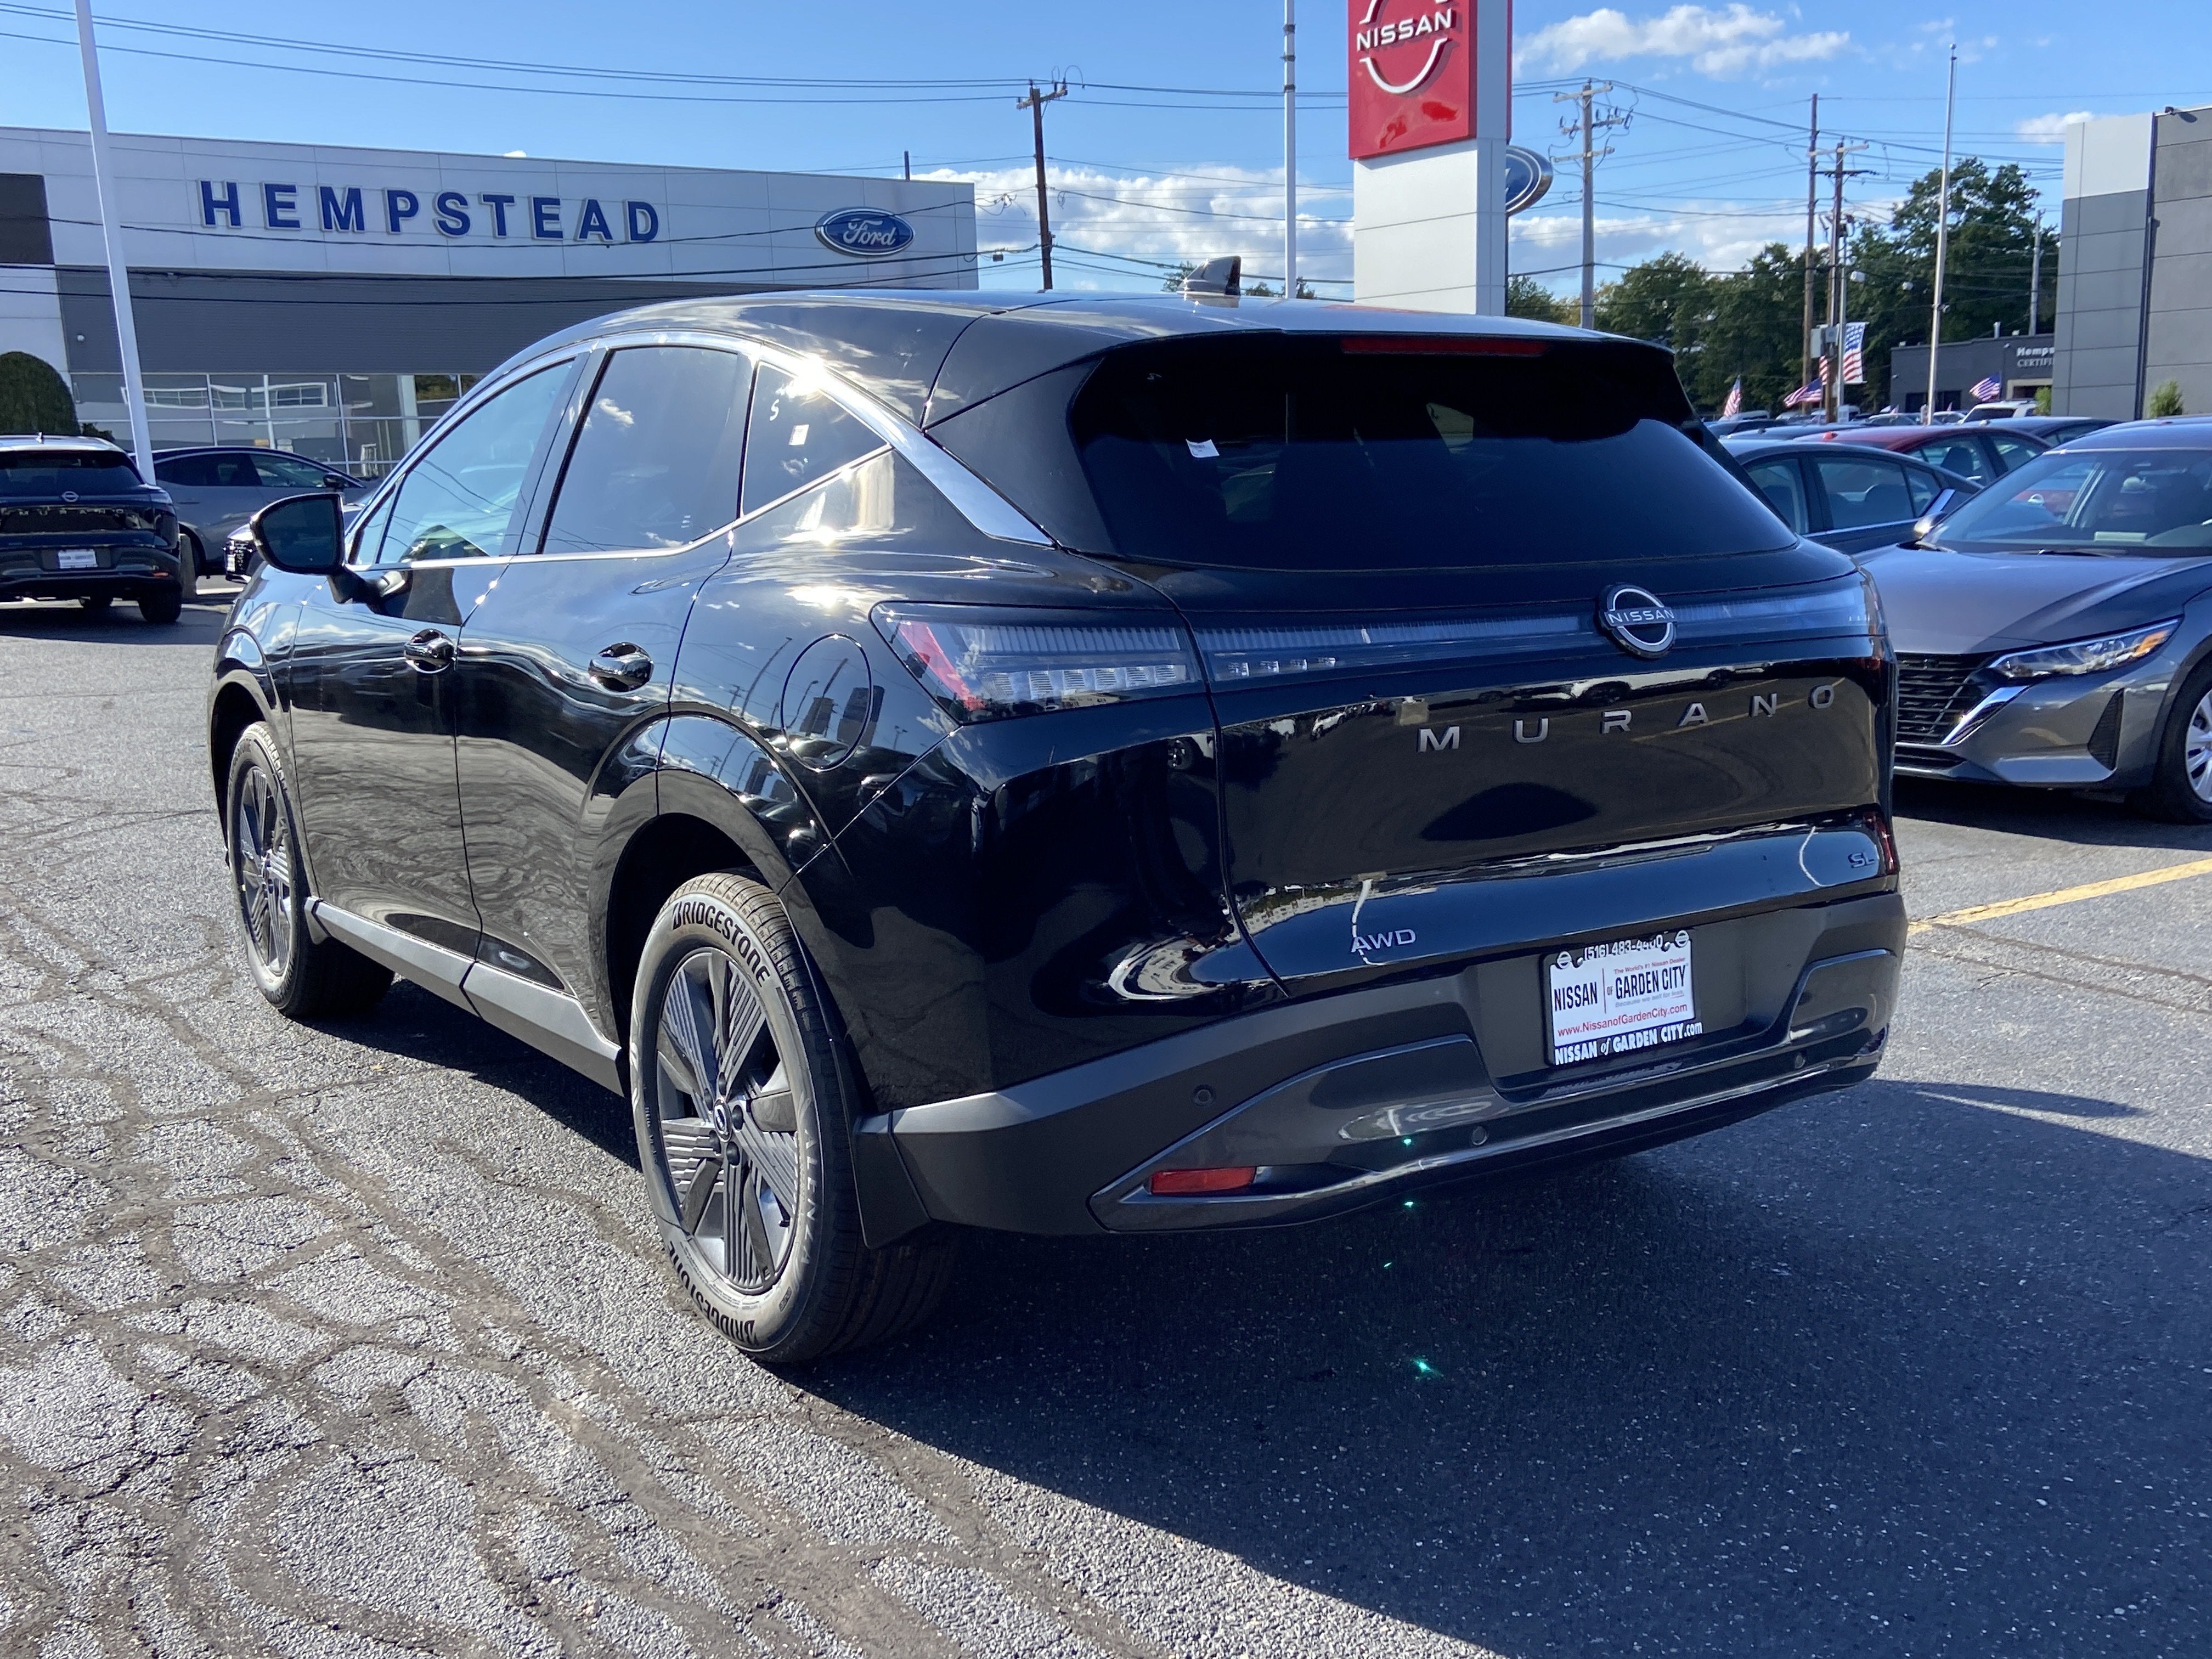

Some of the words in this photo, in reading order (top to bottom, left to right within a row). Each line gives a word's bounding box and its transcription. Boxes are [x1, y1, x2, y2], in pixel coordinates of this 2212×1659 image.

[1356, 8, 1454, 52] NISSAN
[197, 179, 661, 244] HEMPSTEAD
[842, 218, 896, 246] Ford
[1607, 609, 1675, 624] NISSAN
[1417, 684, 1835, 753] MURANO
[1848, 852, 1875, 868] SL
[672, 901, 770, 988] BRIDGESTONE
[1351, 928, 1417, 953] AWD
[1584, 943, 1609, 961] (516)
[1554, 981, 1598, 1012] NISSAN
[1615, 969, 1660, 1000] GARDEN
[1662, 964, 1686, 990] CITY
[1557, 1003, 1688, 1037] www.NissanofGardenCity.com
[1555, 1040, 1598, 1065] NISSAN
[1600, 1037, 1611, 1055] of
[1612, 1029, 1658, 1053] GARDEN
[1661, 1022, 1703, 1043] CITY.com
